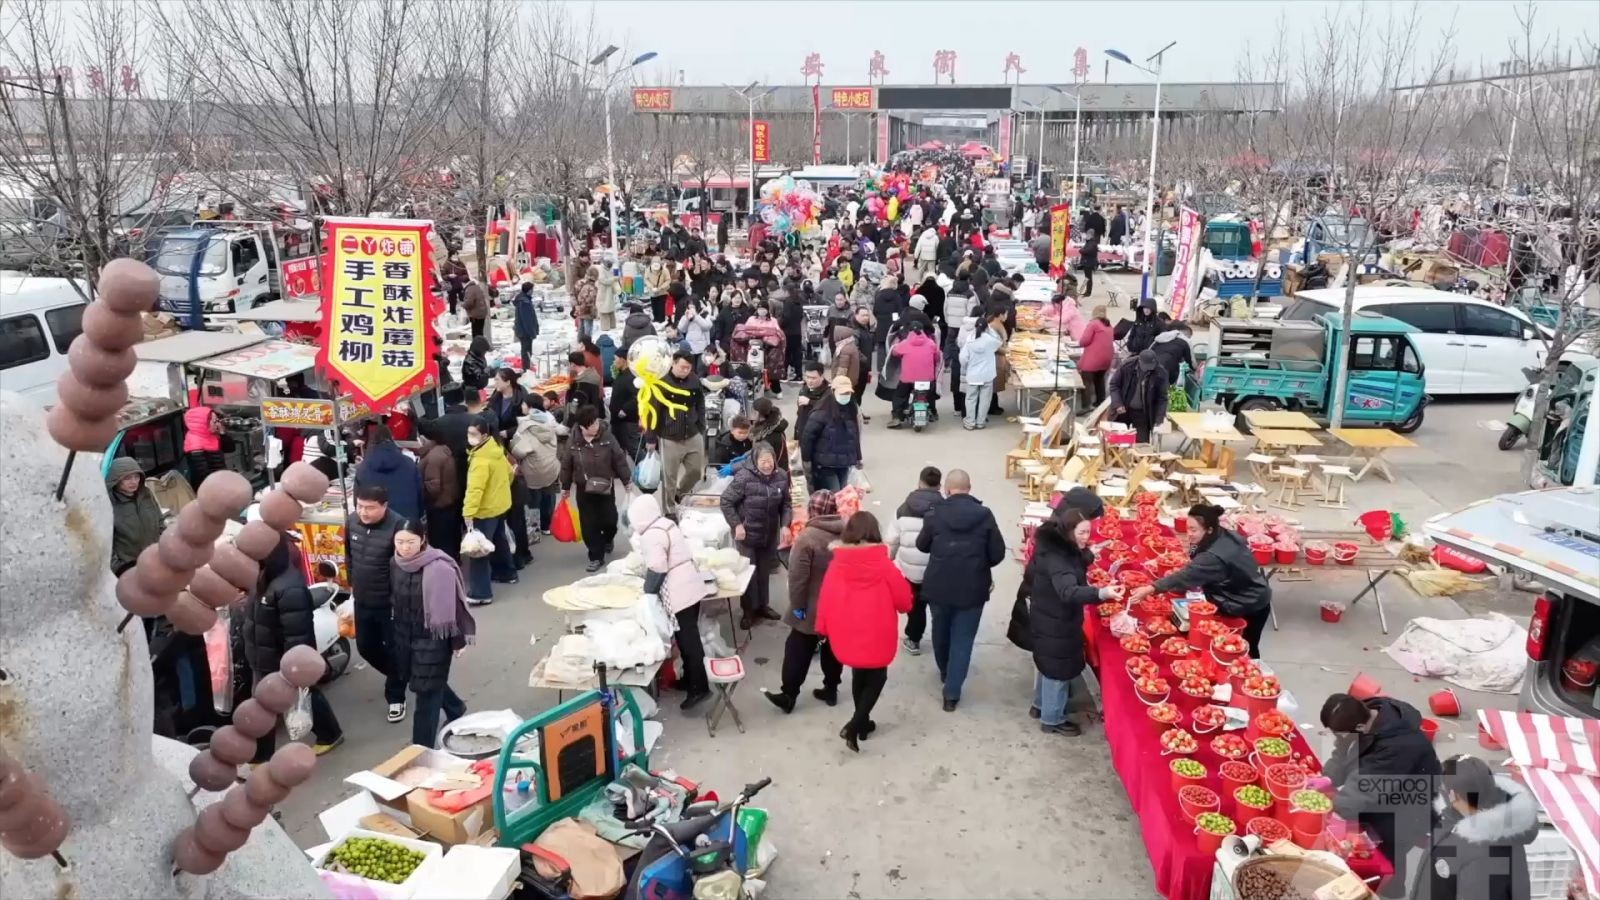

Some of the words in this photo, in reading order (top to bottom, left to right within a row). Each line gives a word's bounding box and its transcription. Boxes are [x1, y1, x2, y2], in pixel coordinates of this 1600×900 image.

[834, 90, 871, 107] 特色小吃区
[339, 260, 375, 363] 手工鸡柳
[382, 262, 415, 368] 香酥炸蘑菇
